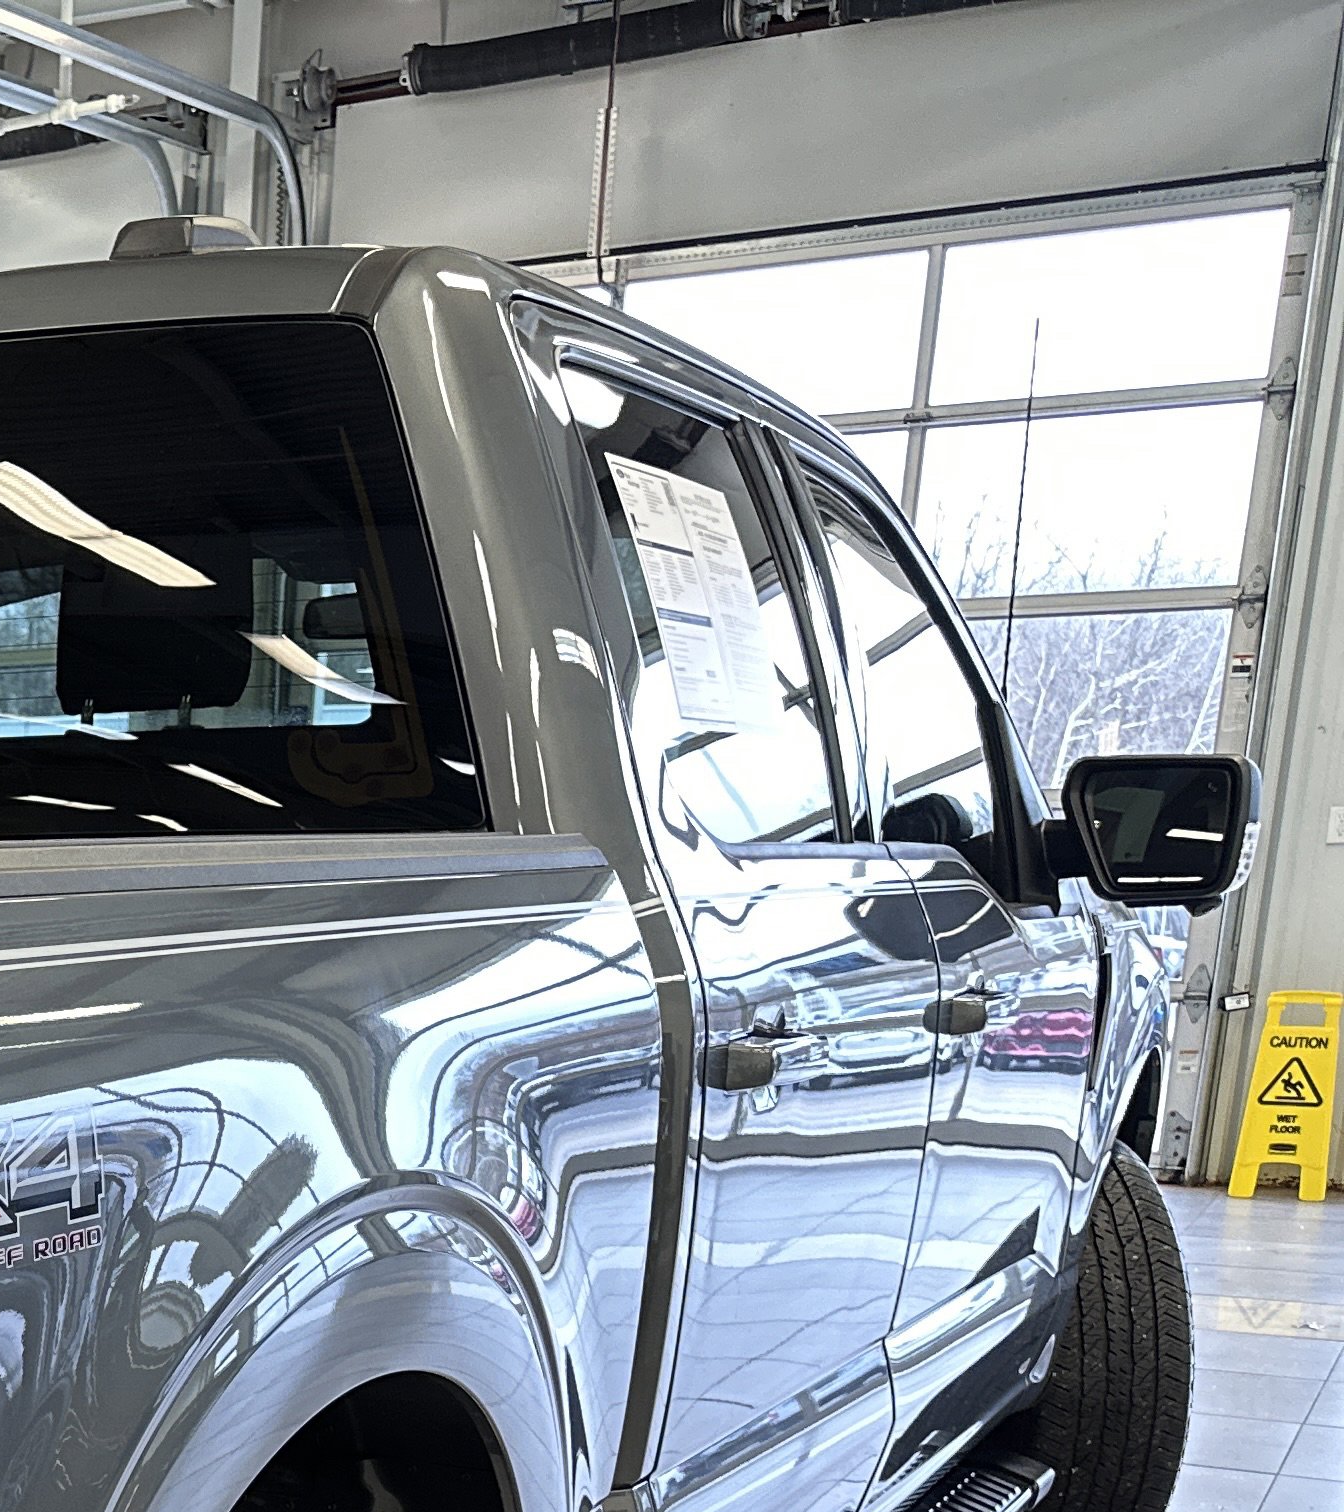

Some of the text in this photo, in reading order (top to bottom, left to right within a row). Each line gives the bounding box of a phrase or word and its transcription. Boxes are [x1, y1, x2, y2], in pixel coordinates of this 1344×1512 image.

[1269, 1035, 1329, 1049] CAUTION
[1276, 1114, 1298, 1123] WET
[1269, 1125, 1301, 1134] FLOOR
[33, 1225, 103, 1262] ROAD
